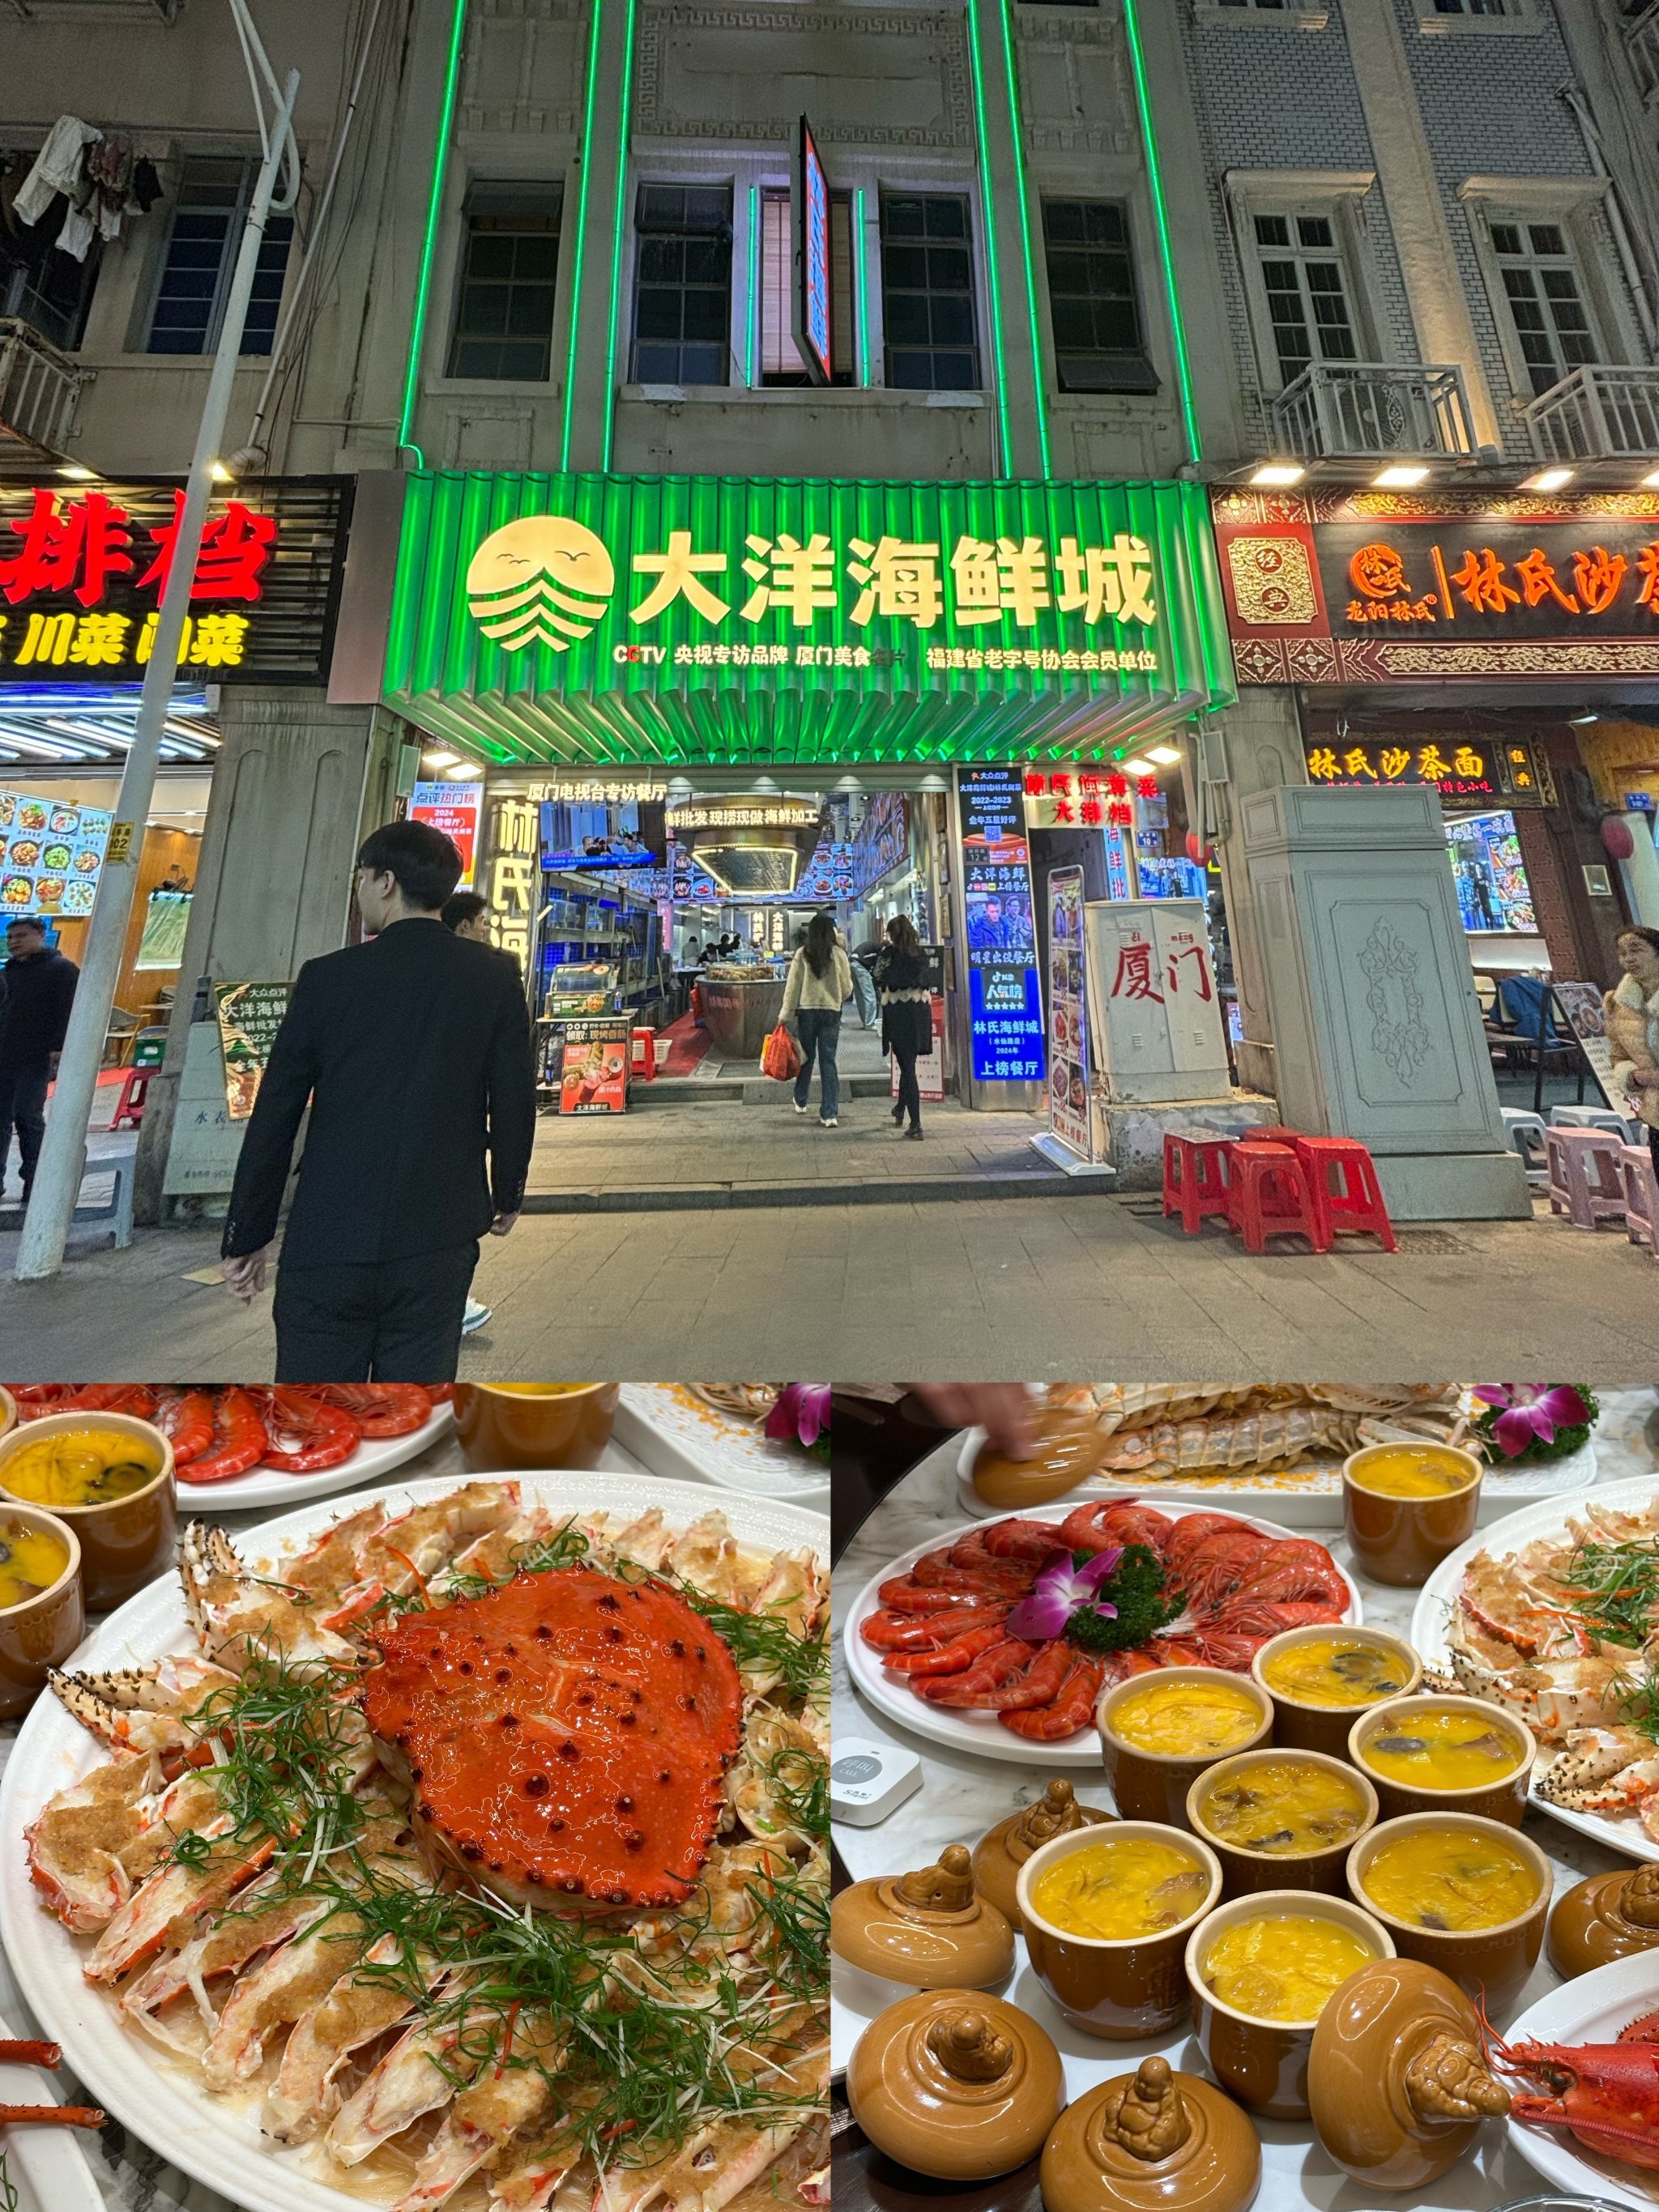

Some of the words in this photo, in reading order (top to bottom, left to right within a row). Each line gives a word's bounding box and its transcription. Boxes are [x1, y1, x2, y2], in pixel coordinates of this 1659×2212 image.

[629, 531, 1157, 628] 大洋海鲜城
[15, 613, 130, 665] 川菜
[613, 646, 667, 663] CCTV
[675, 645, 788, 666] 央视专访品牌
[927, 647, 1157, 671] 福建省老字号协会会员单位
[1308, 745, 1483, 779] 林氏沙茶面
[416, 793, 475, 803] 点评热门榜
[527, 783, 667, 802] 厦门电视台专访餐厅
[971, 796, 1012, 804] 2022-2023
[1055, 800, 1132, 825] 大排档
[969, 816, 1017, 825] 全年五星好评
[970, 867, 1026, 880] 大洋海鲜
[1111, 943, 1211, 1004] 厦门
[249, 988, 287, 998] 大众点评
[987, 984, 1022, 999] 人气榜
[224, 1001, 288, 1017] 大洋海鲜
[234, 1019, 282, 1031] 海鲜批发
[974, 1021, 1039, 1034] 林氏海鲜城
[996, 1046, 1019, 1055] 2024年
[981, 1060, 1038, 1076] 上榜餐厅
[842, 1758, 874, 1773] 呼叫
